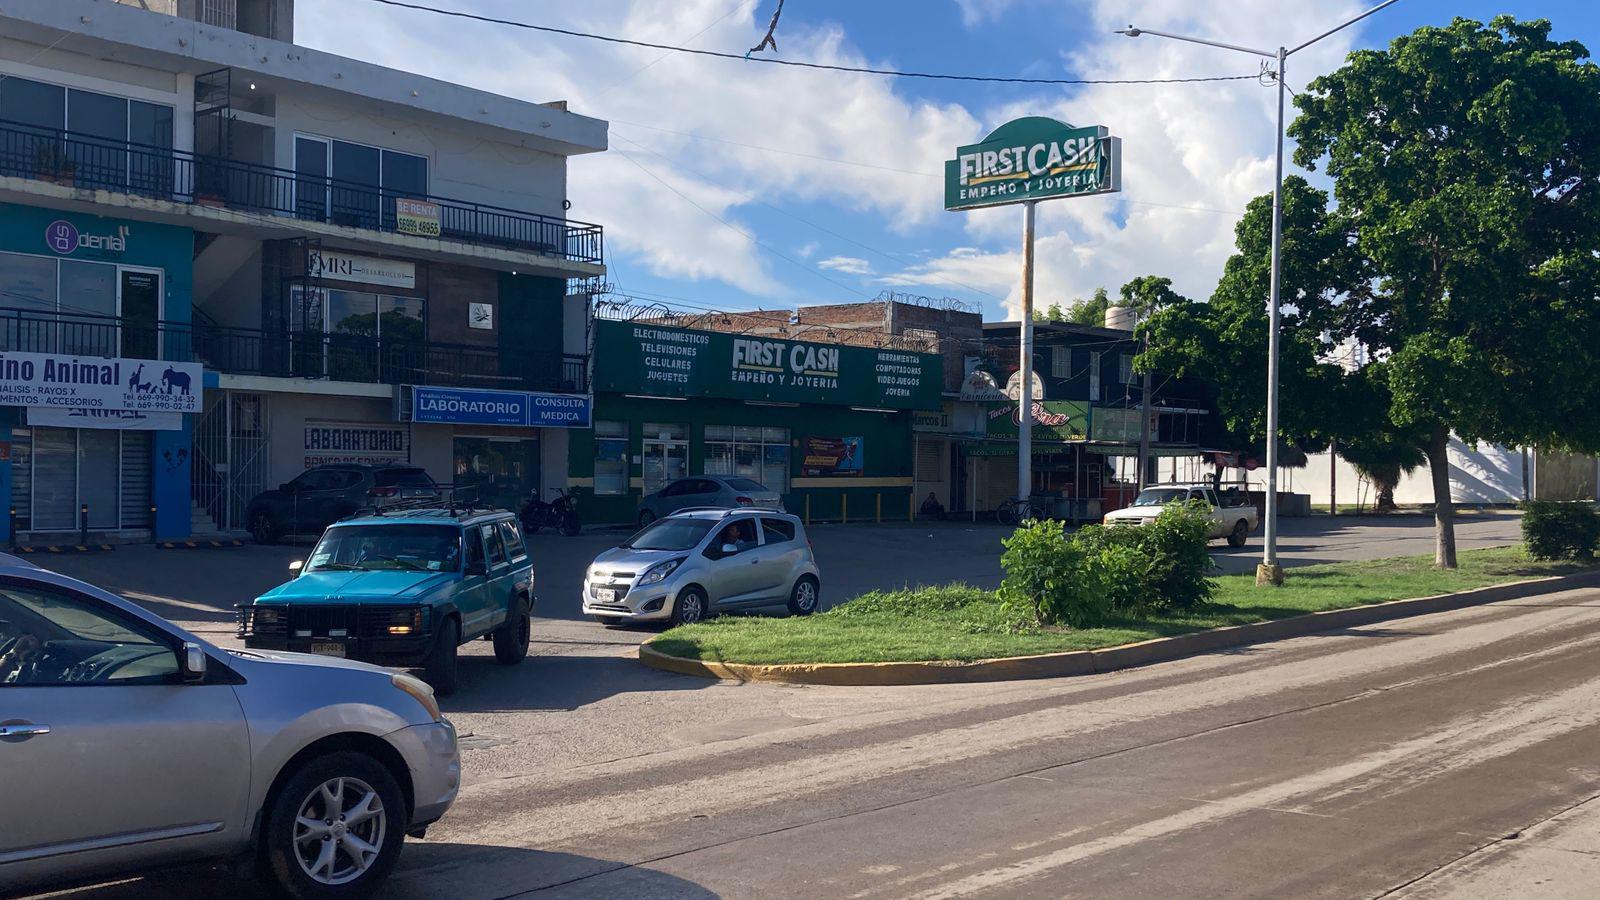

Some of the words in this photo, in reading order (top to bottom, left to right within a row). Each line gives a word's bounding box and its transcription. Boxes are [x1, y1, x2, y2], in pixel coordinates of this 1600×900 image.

[959, 147, 1026, 186] FIRST
[1028, 136, 1096, 176] CASH
[960, 180, 1016, 200] EMPEÑO
[1024, 182, 1030, 192] Y
[1038, 174, 1098, 190] JOYERIA
[411, 203, 437, 219] RENTA
[80, 226, 126, 251] dental
[632, 328, 710, 344] ELECTRODOMESTICOS
[641, 342, 697, 356] TELEVISIONES
[645, 356, 692, 370] CELULARES
[733, 339, 786, 369] FIRST
[790, 344, 839, 374] CASH
[878, 353, 920, 364] HERRAMIENTAS
[43, 359, 120, 386] Animal
[647, 370, 688, 383] JUGUETES
[875, 364, 922, 375] COMPUTADORAS
[732, 370, 774, 384] EMPEÑO
[779, 374, 785, 385] Y
[791, 376, 838, 389] JOYERIA
[38, 386, 68, 396] RAYOS
[70, 387, 76, 396] X
[137, 393, 195, 403] 669-990-34-32
[885, 387, 910, 397] JOYERIA
[45, 397, 103, 407] ACCESORIOS
[137, 402, 195, 411] 669-990-02-47
[420, 399, 520, 414] LABORATORIO
[535, 397, 585, 408] CONSULTA
[541, 411, 580, 421] MEDICA
[988, 405, 1011, 420] Tacos
[941, 414, 948, 427] II
[304, 428, 402, 451] LABORATORIO
